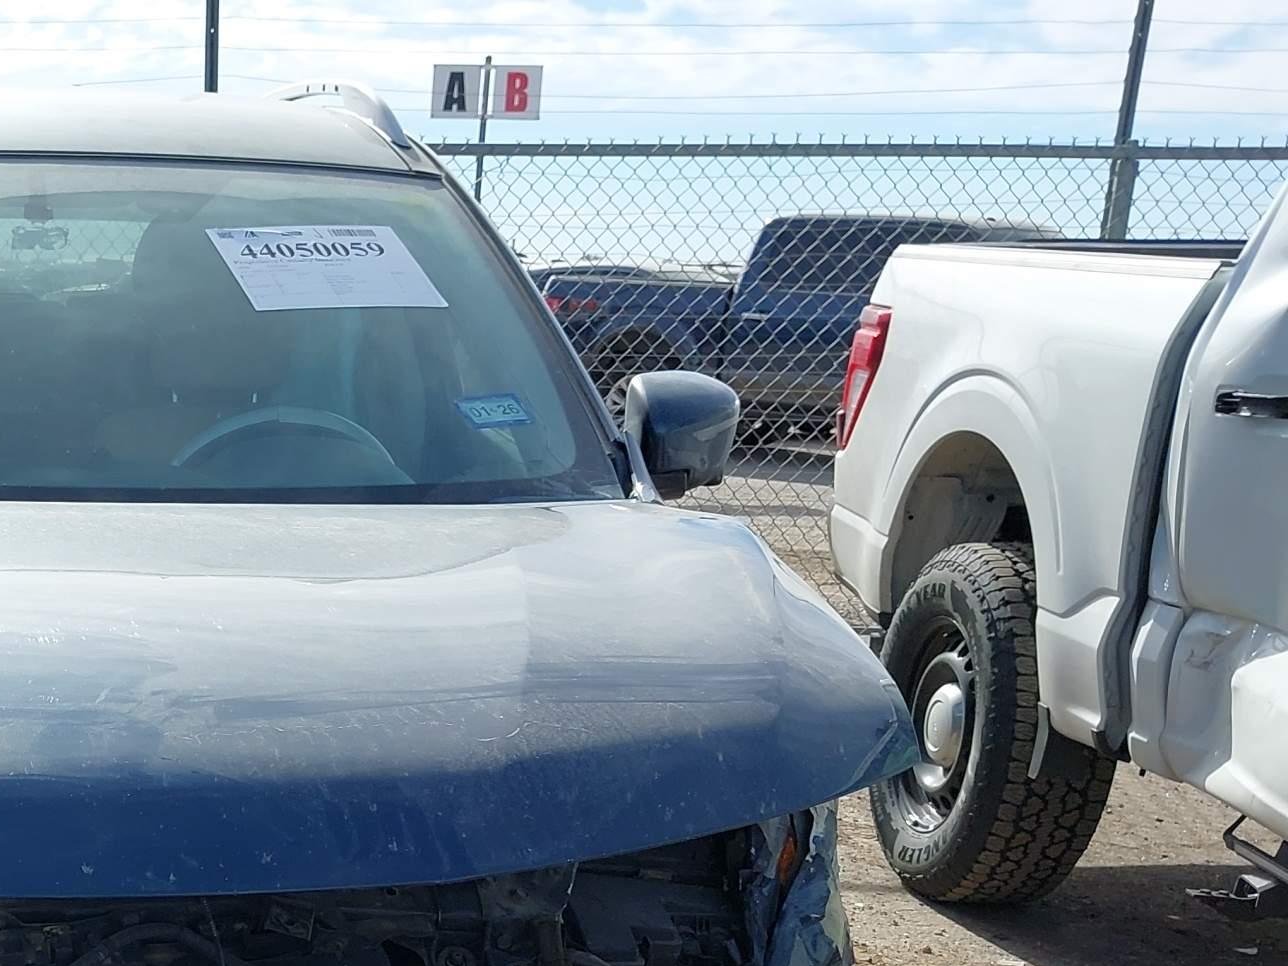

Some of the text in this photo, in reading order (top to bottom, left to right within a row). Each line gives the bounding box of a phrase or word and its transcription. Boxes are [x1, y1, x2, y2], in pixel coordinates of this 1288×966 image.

[442, 72, 529, 112] A B
[239, 242, 385, 259] 44050059
